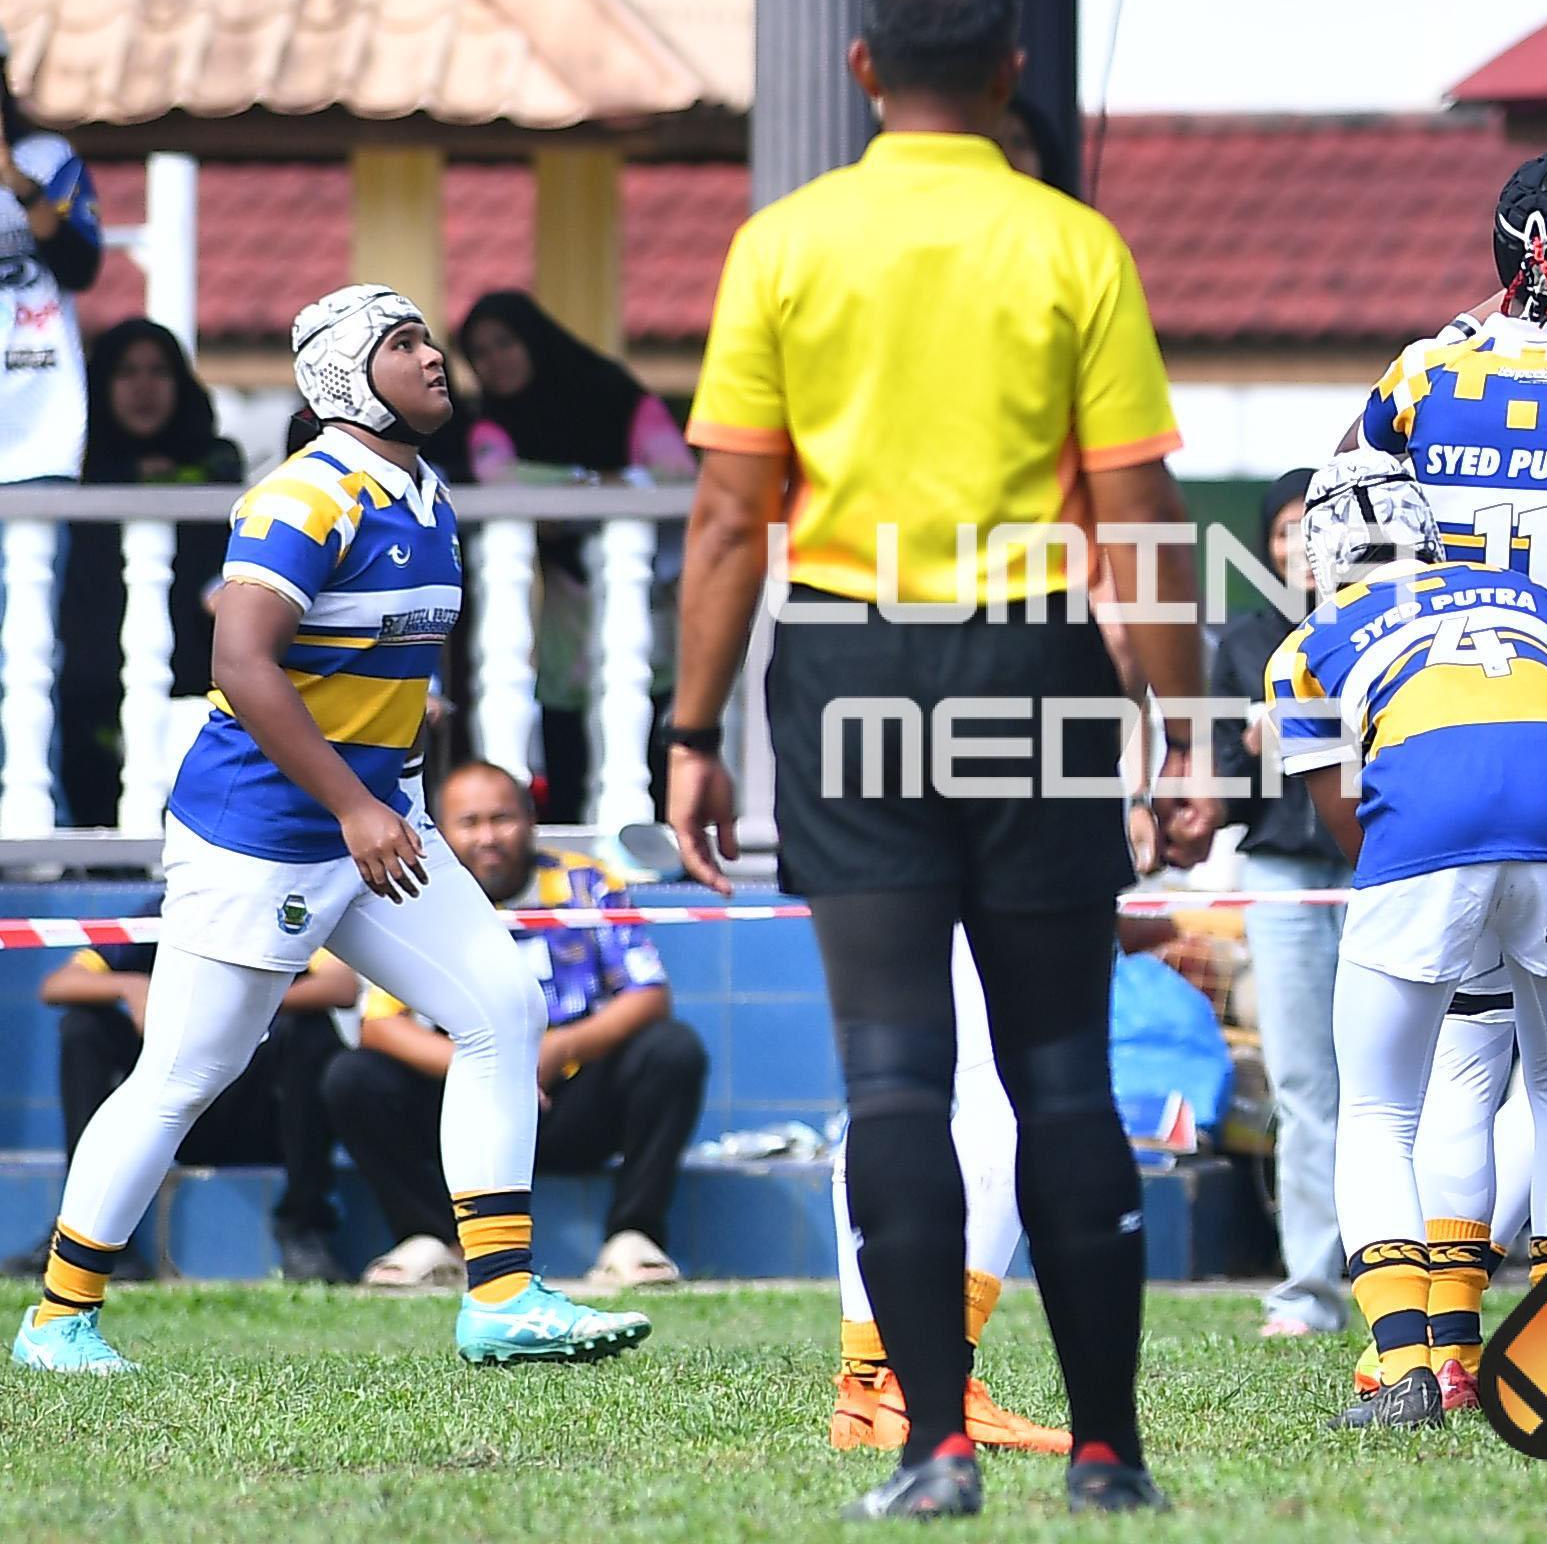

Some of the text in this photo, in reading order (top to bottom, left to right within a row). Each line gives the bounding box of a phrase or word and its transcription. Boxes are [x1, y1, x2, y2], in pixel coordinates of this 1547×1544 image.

[1426, 445, 1501, 478] SYED
[1350, 587, 1537, 652] SYED PUTRA
[1425, 616, 1518, 679] 4
